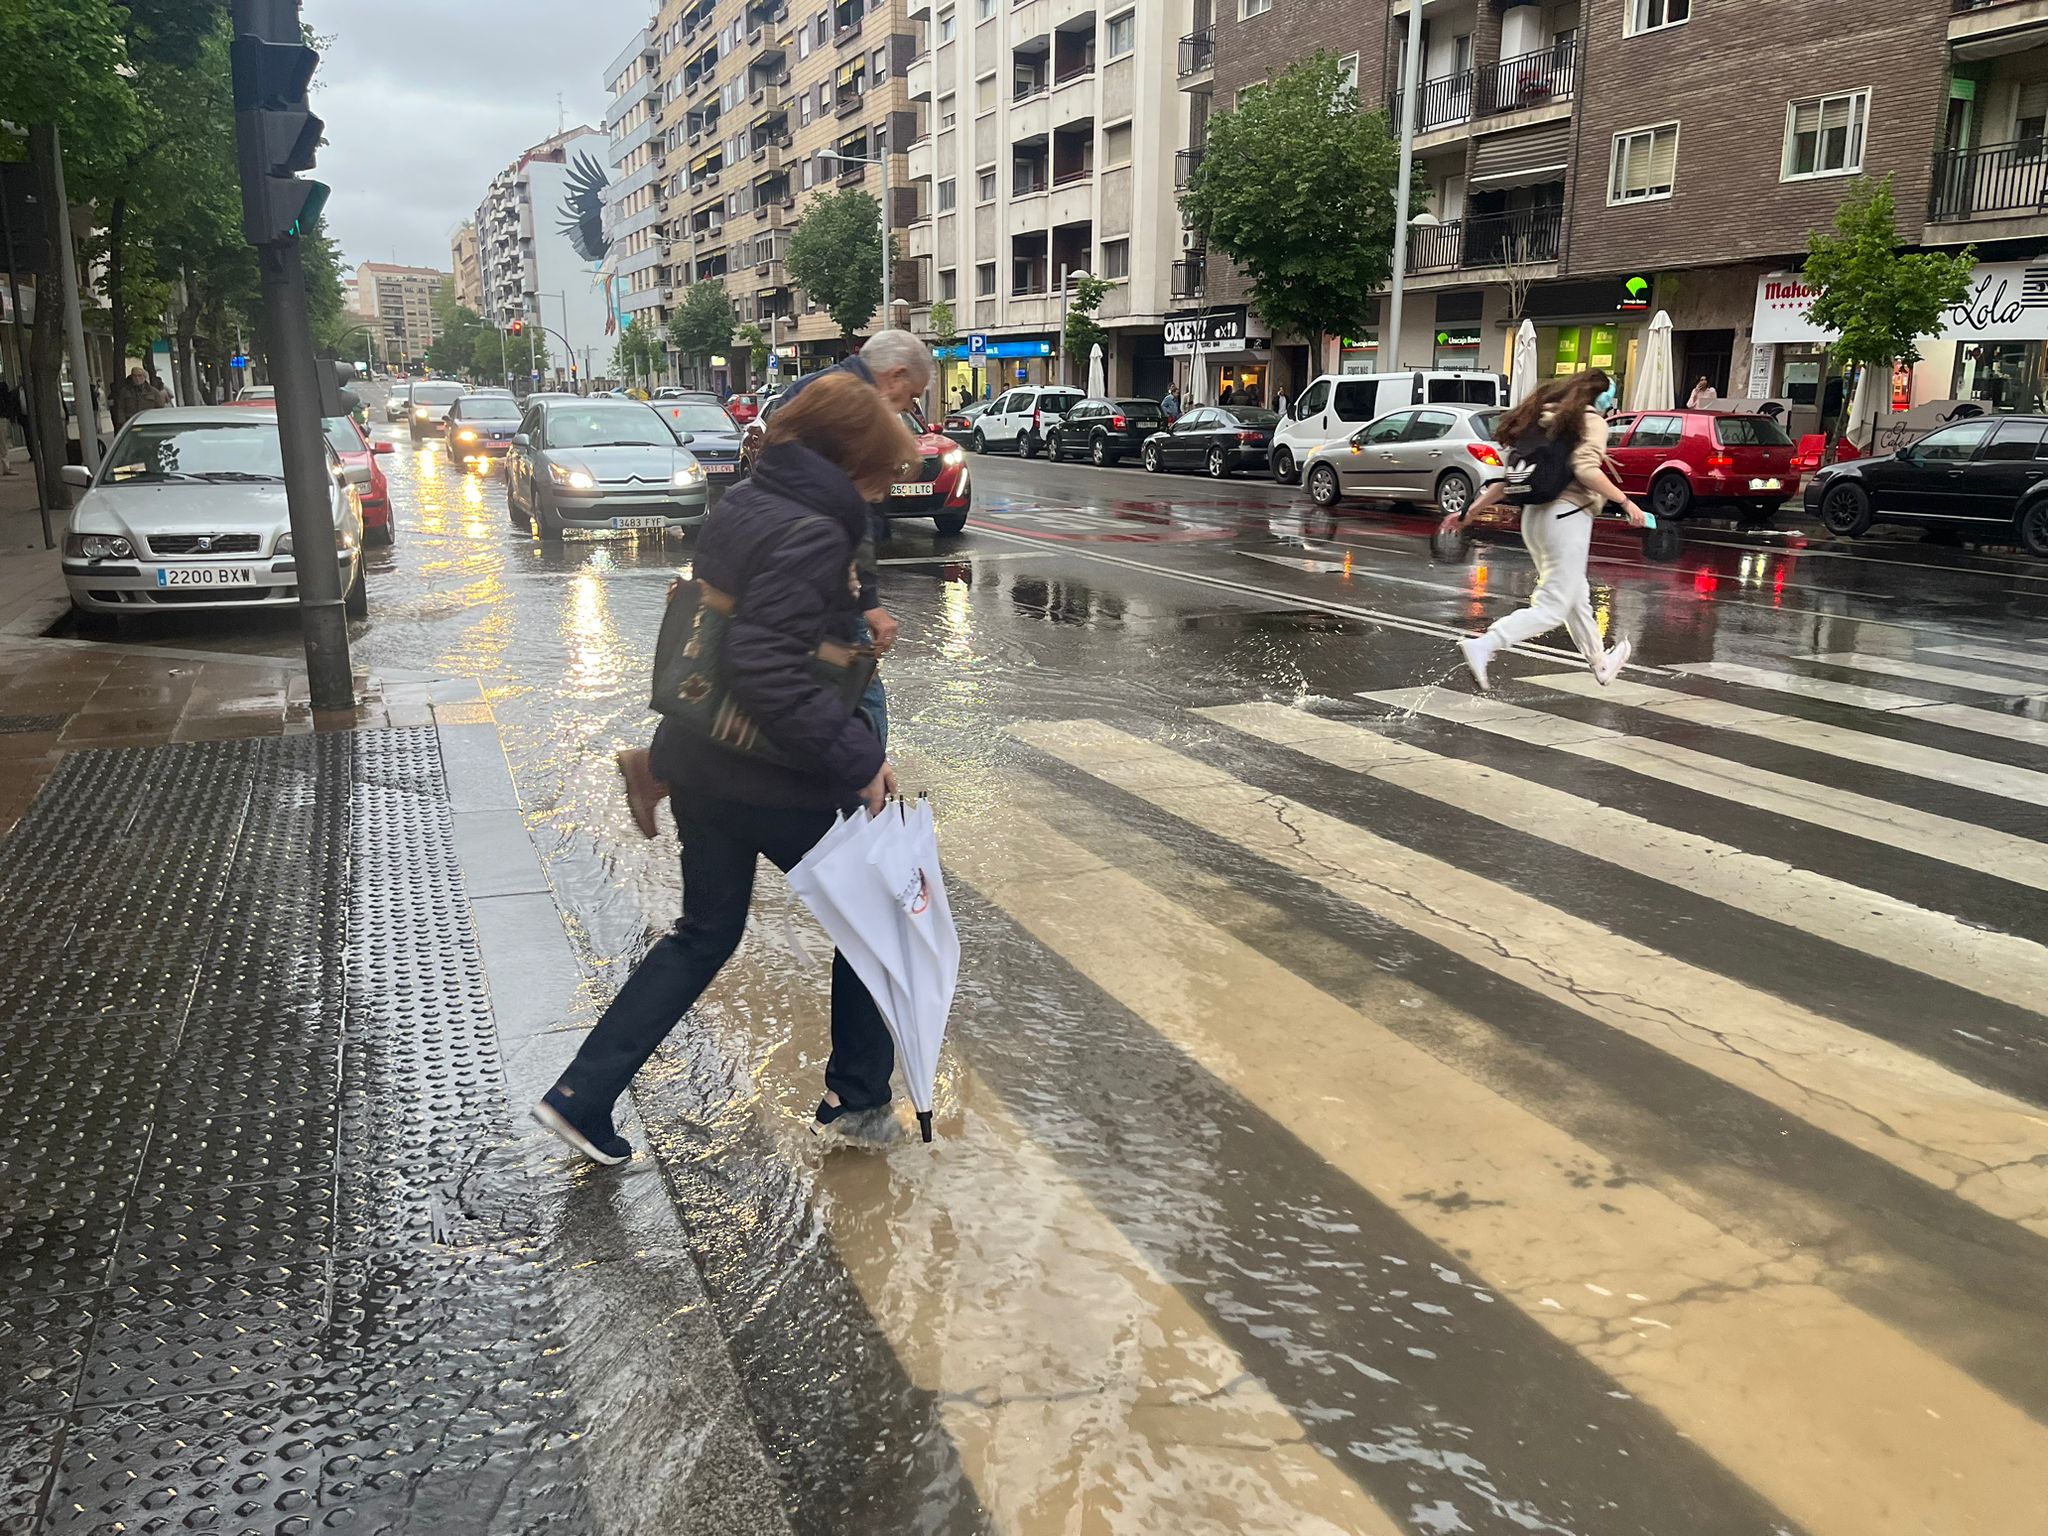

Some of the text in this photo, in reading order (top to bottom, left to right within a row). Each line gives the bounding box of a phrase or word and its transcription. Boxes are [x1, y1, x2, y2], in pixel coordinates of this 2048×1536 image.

[1952, 273, 2026, 331] Lola
[1164, 319, 1207, 342] OKEY!
[971, 336, 983, 352] P
[915, 485, 931, 494] LTC
[619, 517, 662, 528] 3483 FYF
[169, 568, 250, 585] 2200 BXW
